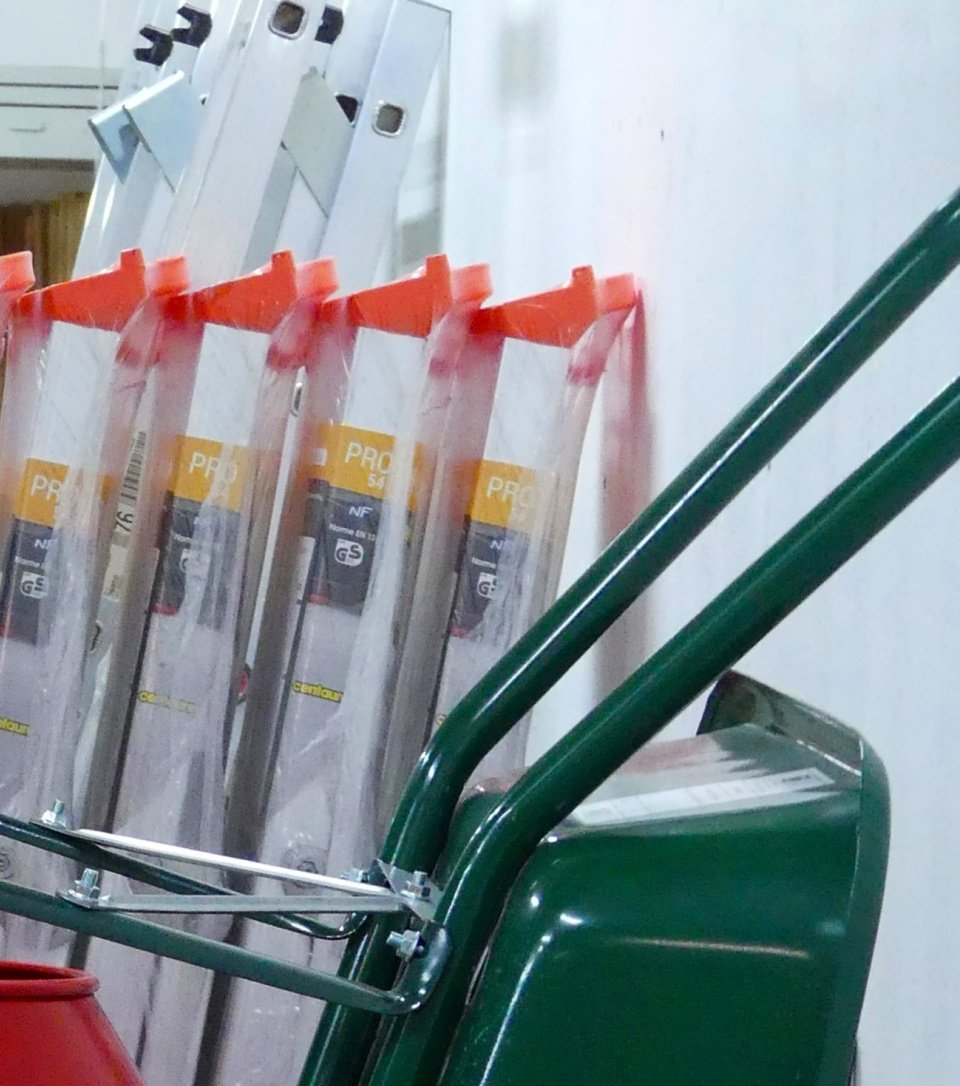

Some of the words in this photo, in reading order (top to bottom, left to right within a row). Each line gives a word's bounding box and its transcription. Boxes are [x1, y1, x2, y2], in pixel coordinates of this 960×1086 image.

[344, 442, 393, 474] PRO
[30, 474, 62, 501] PR
[348, 505, 374, 518] NF
[335, 544, 362, 563] GS
[291, 680, 344, 704] centaur
